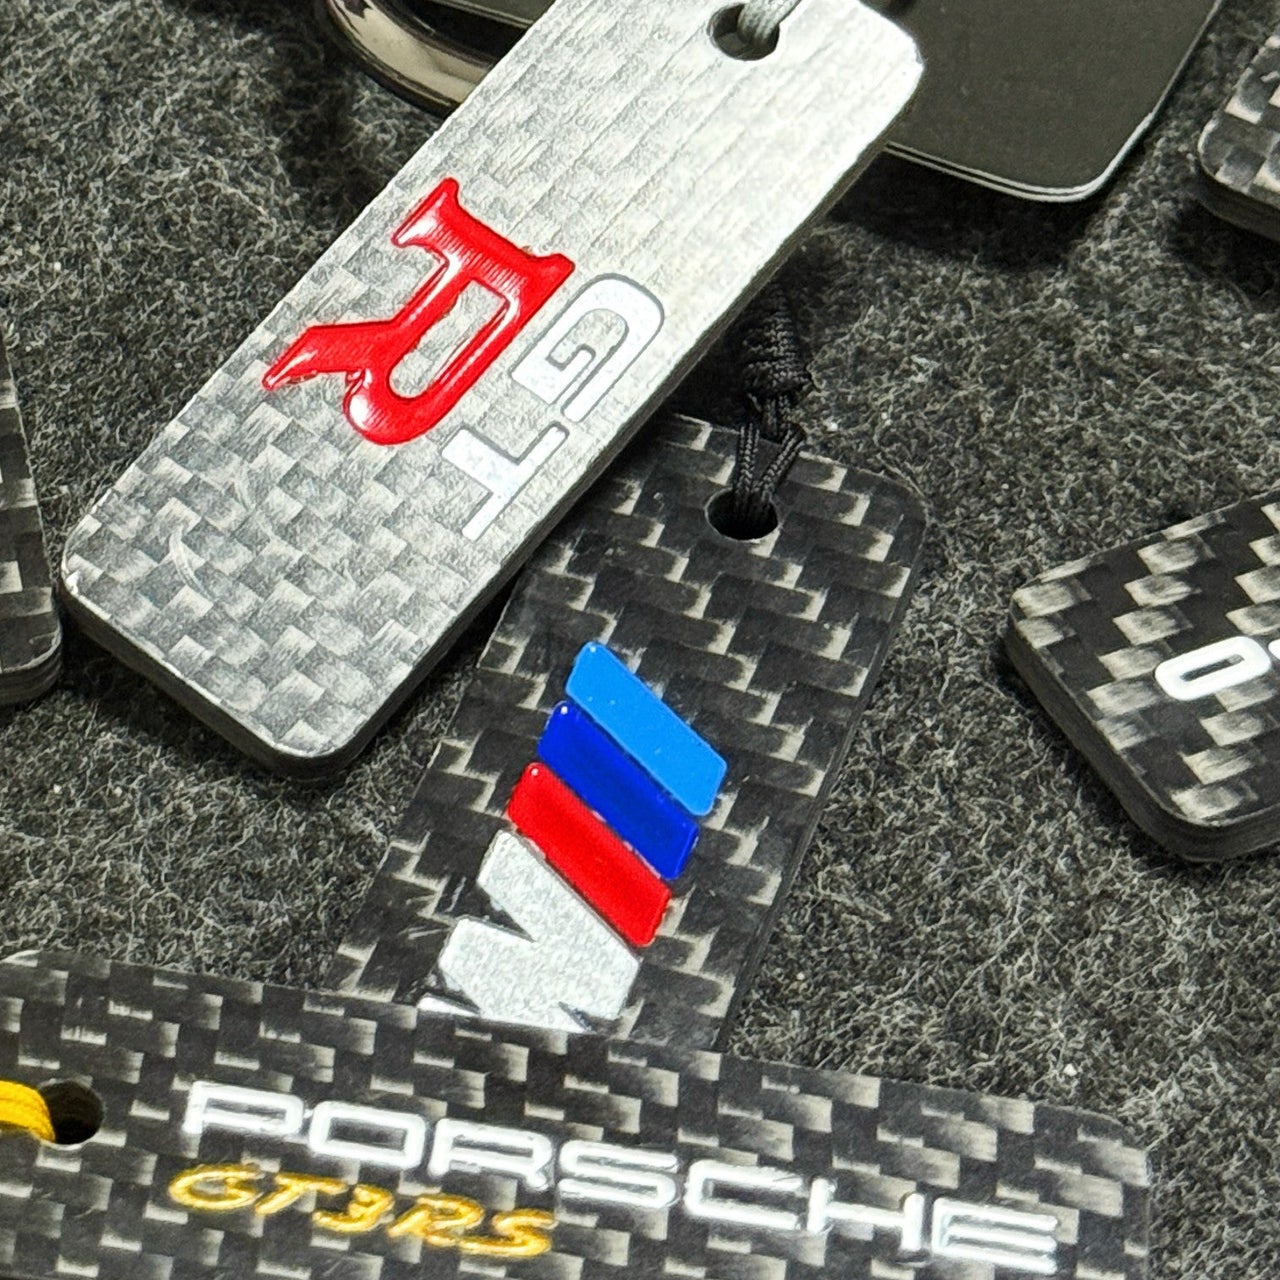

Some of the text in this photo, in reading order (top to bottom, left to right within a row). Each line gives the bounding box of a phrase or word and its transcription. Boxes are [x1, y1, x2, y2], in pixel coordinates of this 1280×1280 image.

[262, 177, 575, 445] R
[442, 273, 664, 541] GT
[168, 1163, 558, 1258] GT3RS
[184, 1079, 1059, 1274] PORSCHE
